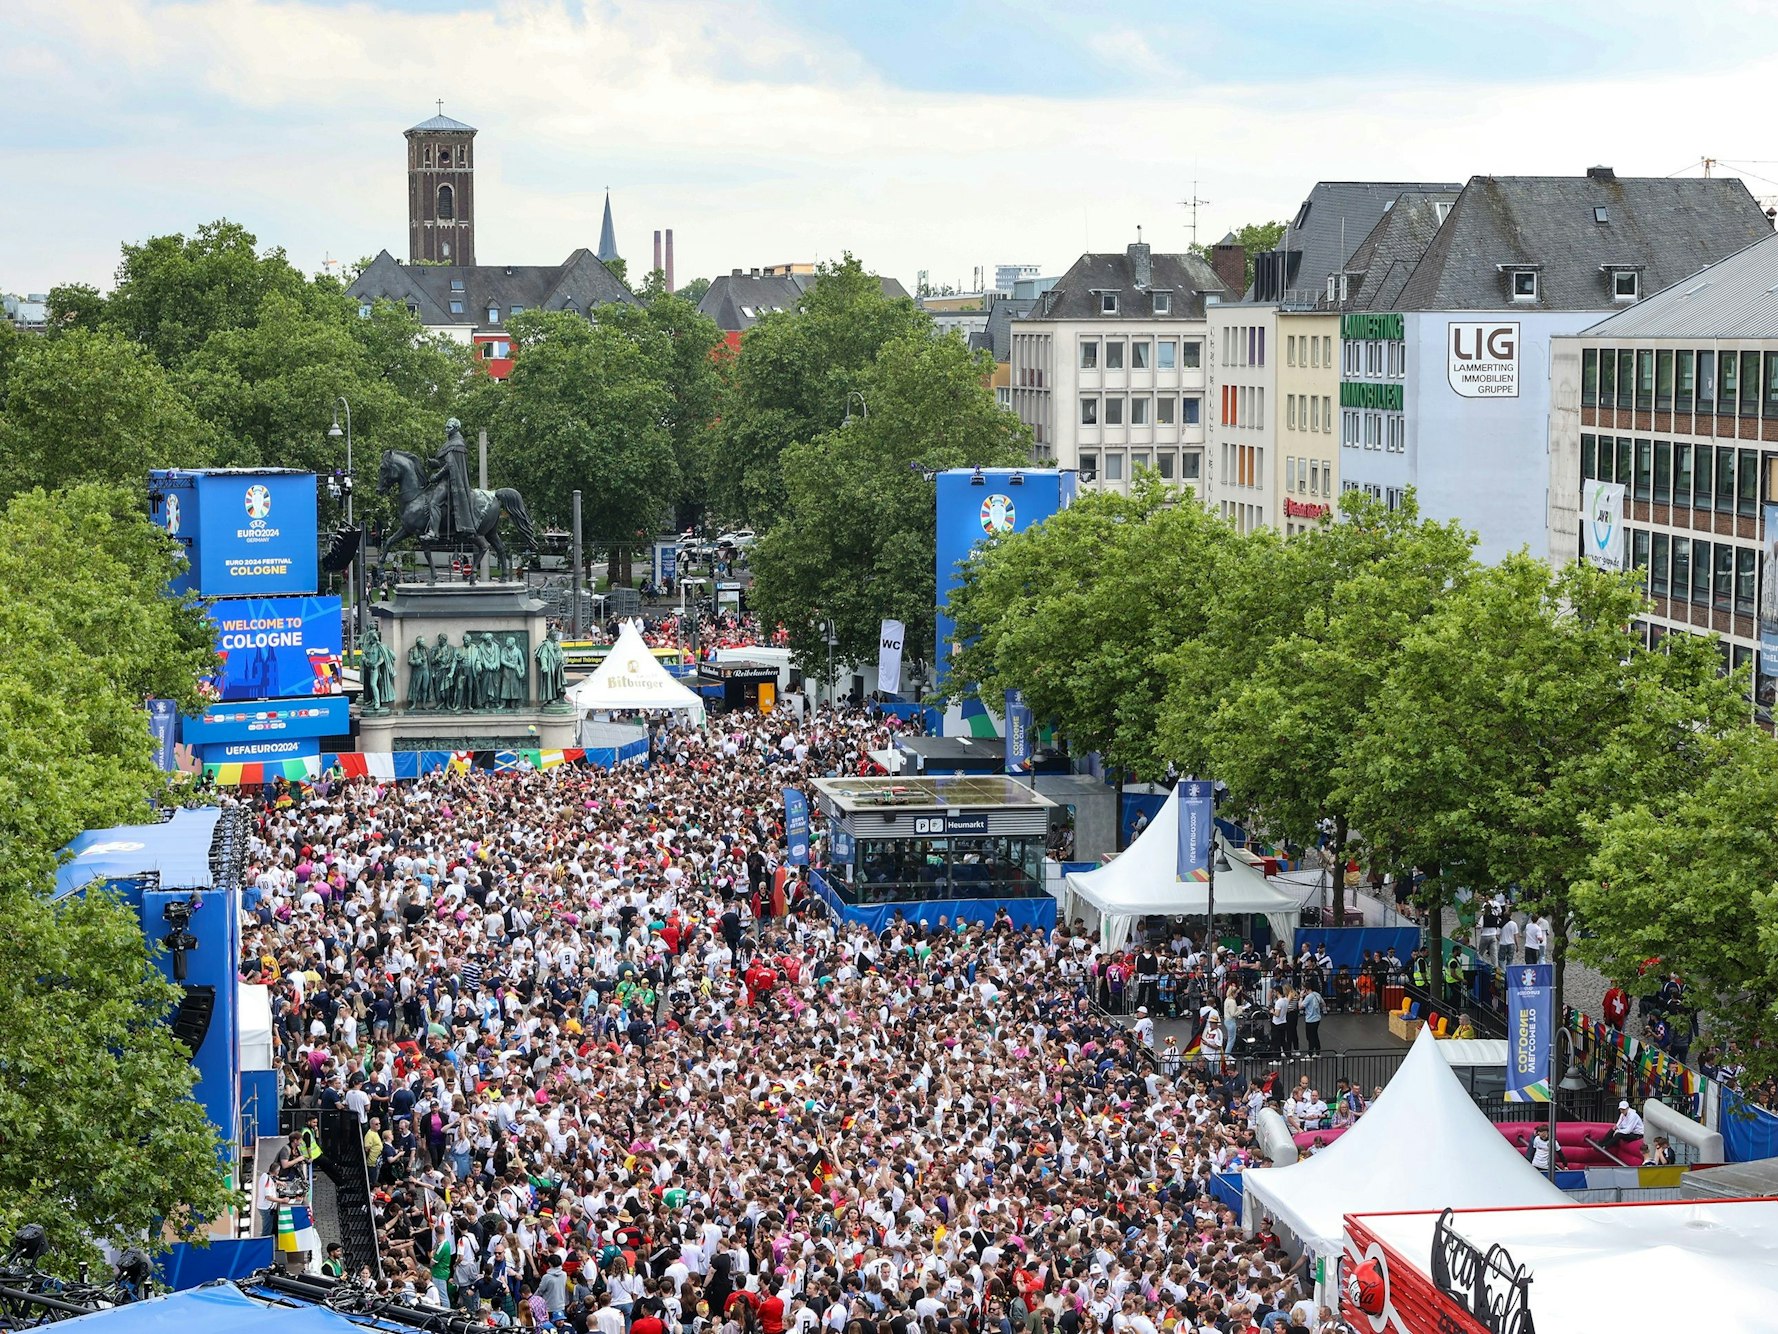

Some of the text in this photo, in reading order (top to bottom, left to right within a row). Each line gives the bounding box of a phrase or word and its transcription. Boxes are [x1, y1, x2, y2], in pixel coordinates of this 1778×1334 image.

[1339, 312, 1404, 339] LAMMERTING
[1454, 328, 1514, 360] LIG
[1453, 363, 1514, 372] LAMMERTING
[1461, 374, 1514, 383] IMMOBILIEN
[1477, 385, 1514, 394] GRUPPE
[1339, 381, 1404, 411] IMMOBILIEN
[237, 528, 280, 538] EURO2024
[244, 558, 262, 566] 2024
[262, 557, 292, 565] FESTIVAL
[230, 565, 287, 576] COLOGNE
[222, 617, 302, 631] WELCOME TO
[222, 632, 303, 650] COLOGNE
[882, 638, 901, 650] WC
[566, 656, 582, 664] Original
[732, 668, 779, 677] Reibekuchen
[607, 675, 664, 689] Bitburger
[225, 742, 299, 755] UEFAEURO2024
[948, 820, 984, 829] Heumarkt
[261, 881, 269, 889] 10
[564, 954, 571, 965] 9
